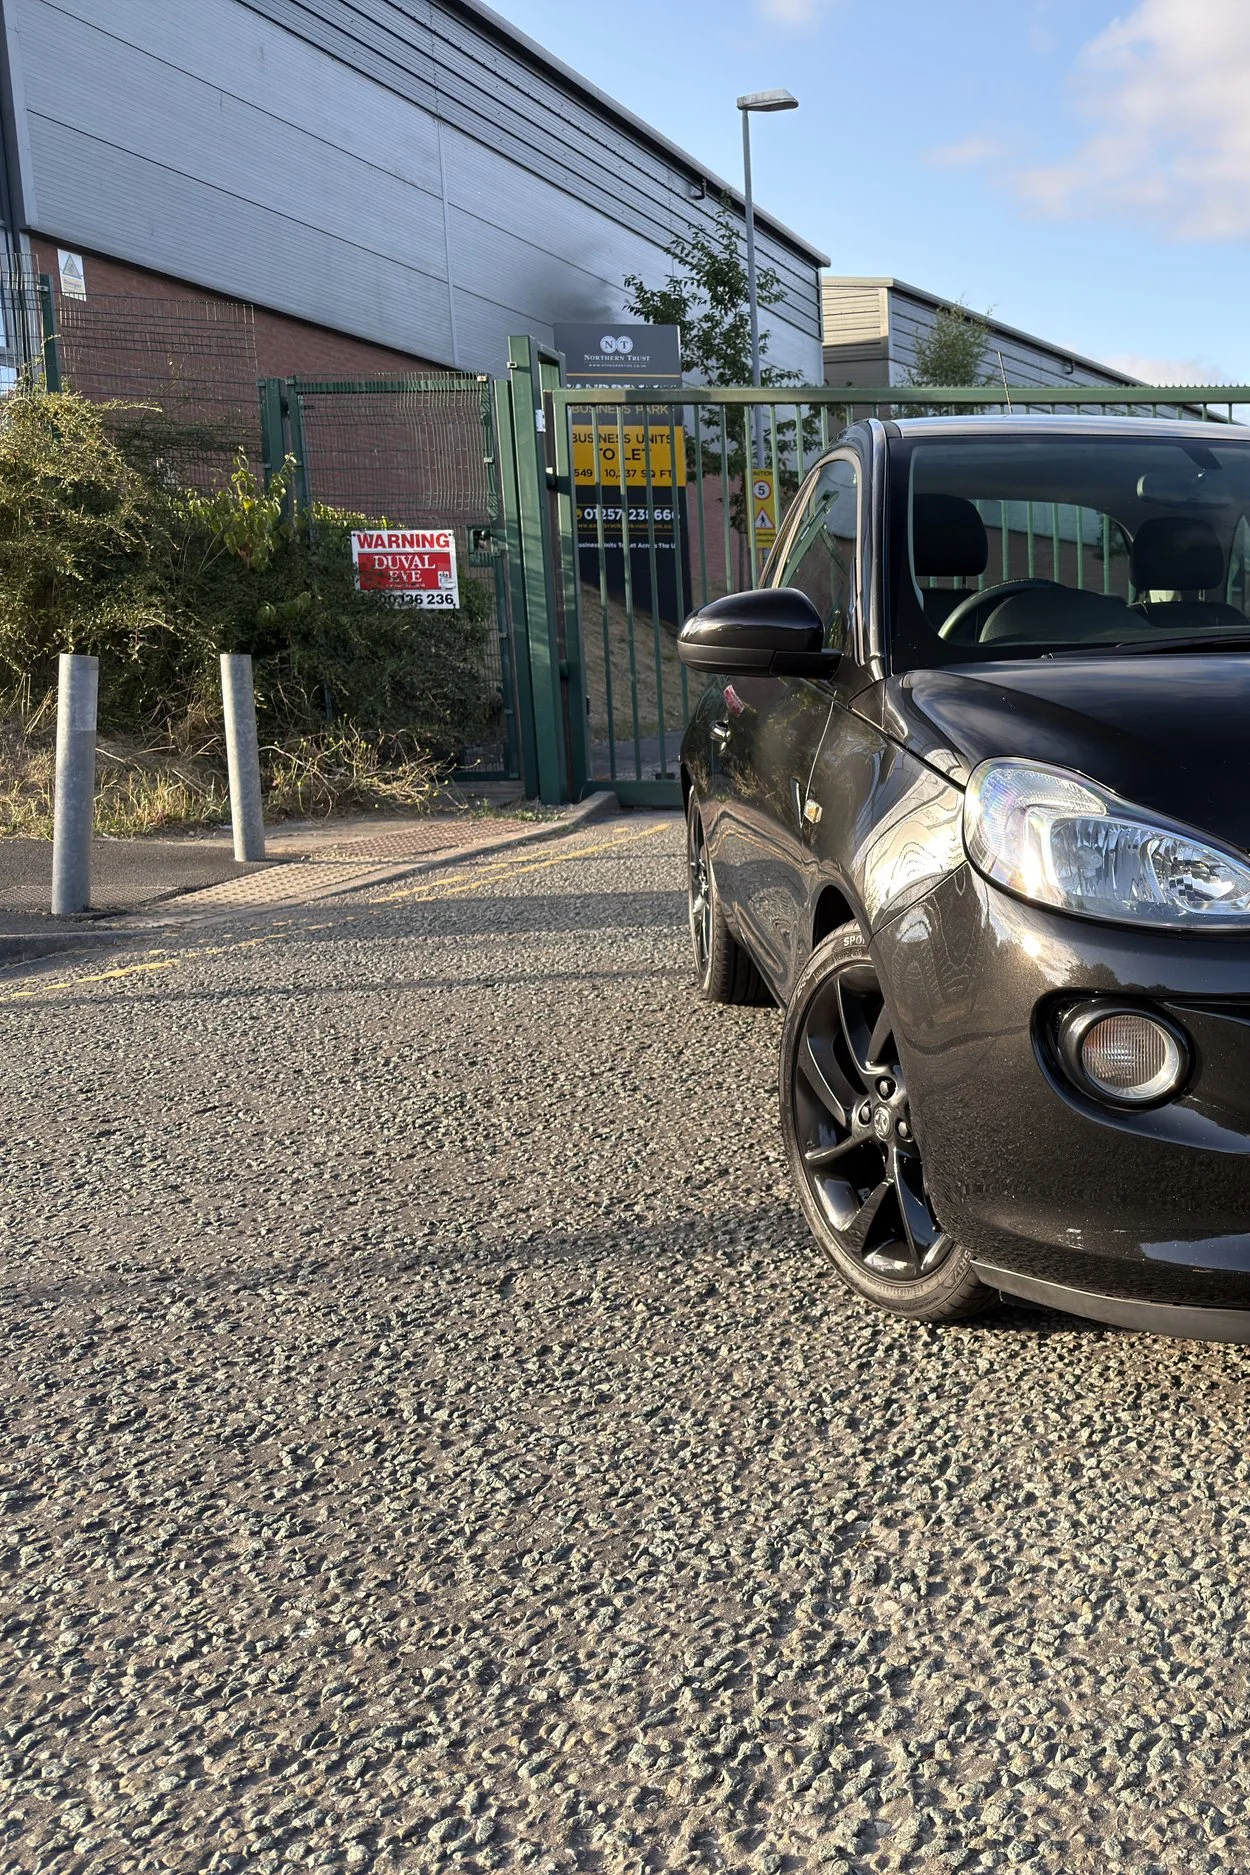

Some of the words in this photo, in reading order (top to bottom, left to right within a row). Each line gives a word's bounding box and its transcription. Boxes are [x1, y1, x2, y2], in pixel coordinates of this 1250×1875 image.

[627, 354, 650, 362] TRUST
[605, 468, 637, 479] 10,37
[758, 485, 766, 496] 5
[356, 533, 450, 549] WARNING
[373, 555, 436, 570] DUVAL
[388, 570, 422, 583] EYE
[427, 593, 454, 605] 236
[843, 934, 865, 947] SPO
